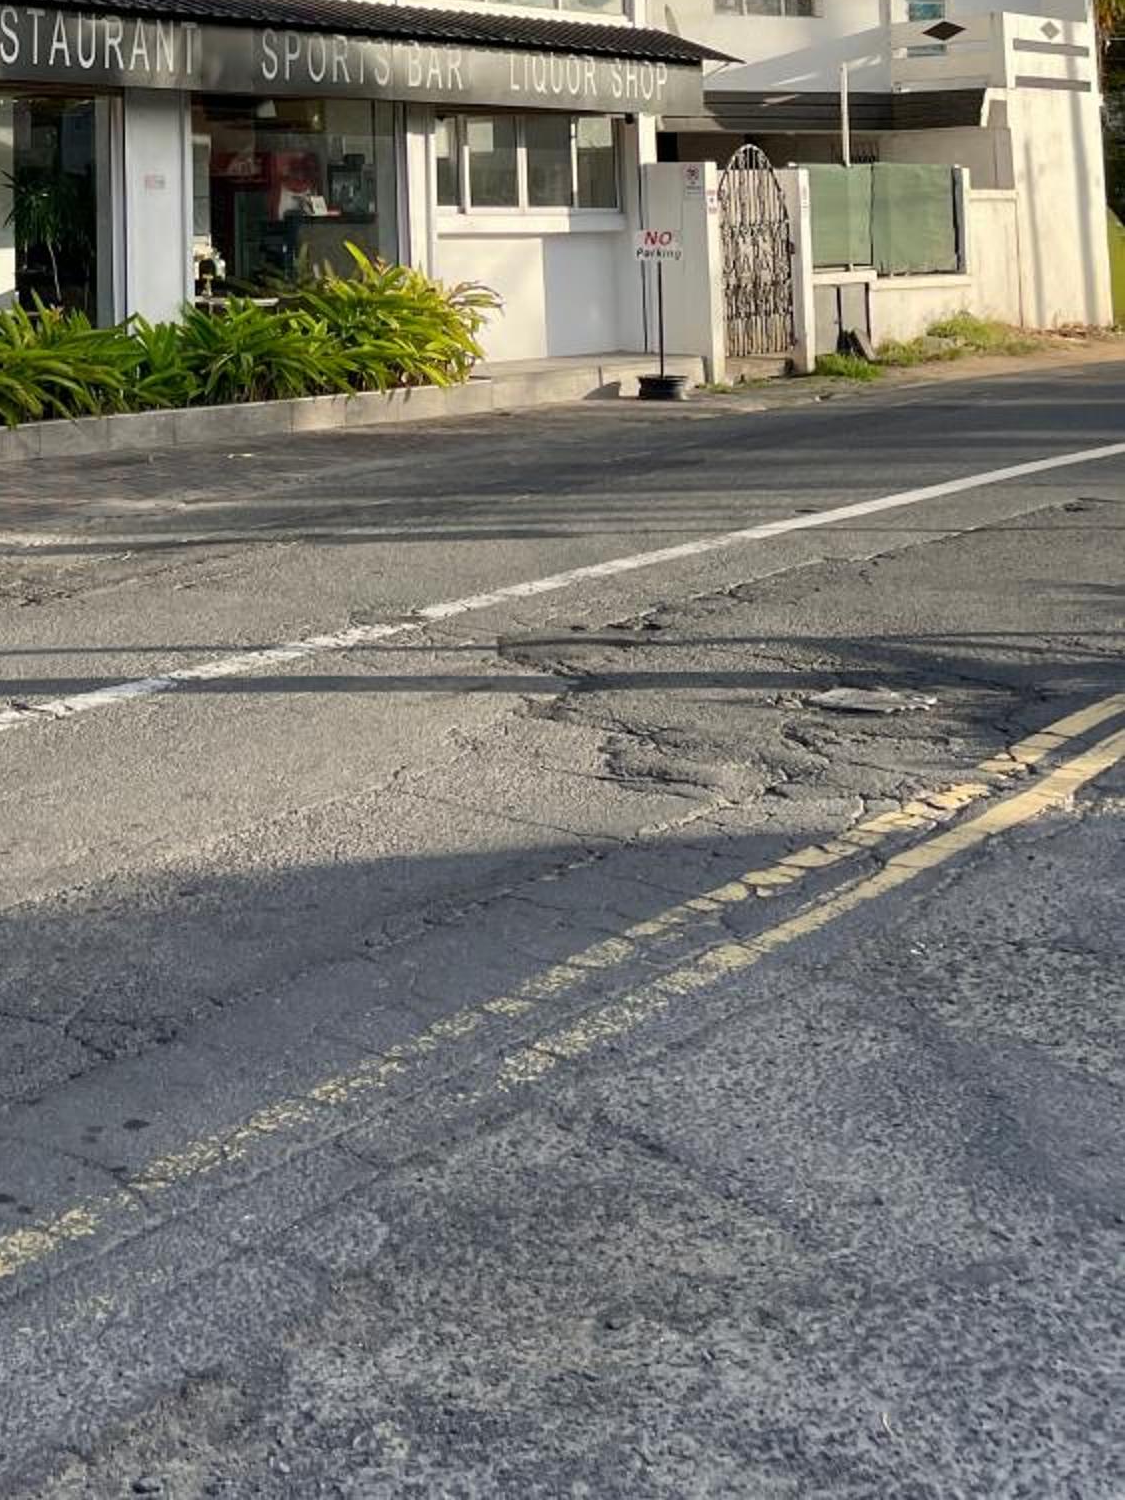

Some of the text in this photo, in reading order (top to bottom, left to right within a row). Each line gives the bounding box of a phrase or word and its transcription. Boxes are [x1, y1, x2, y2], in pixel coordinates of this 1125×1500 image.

[261, 29, 391, 86] SPORTS
[407, 40, 464, 90] BAR
[509, 50, 596, 98] LIQUOR
[611, 58, 668, 101] SHOP
[644, 231, 672, 246] NO
[636, 247, 681, 260] Parking
